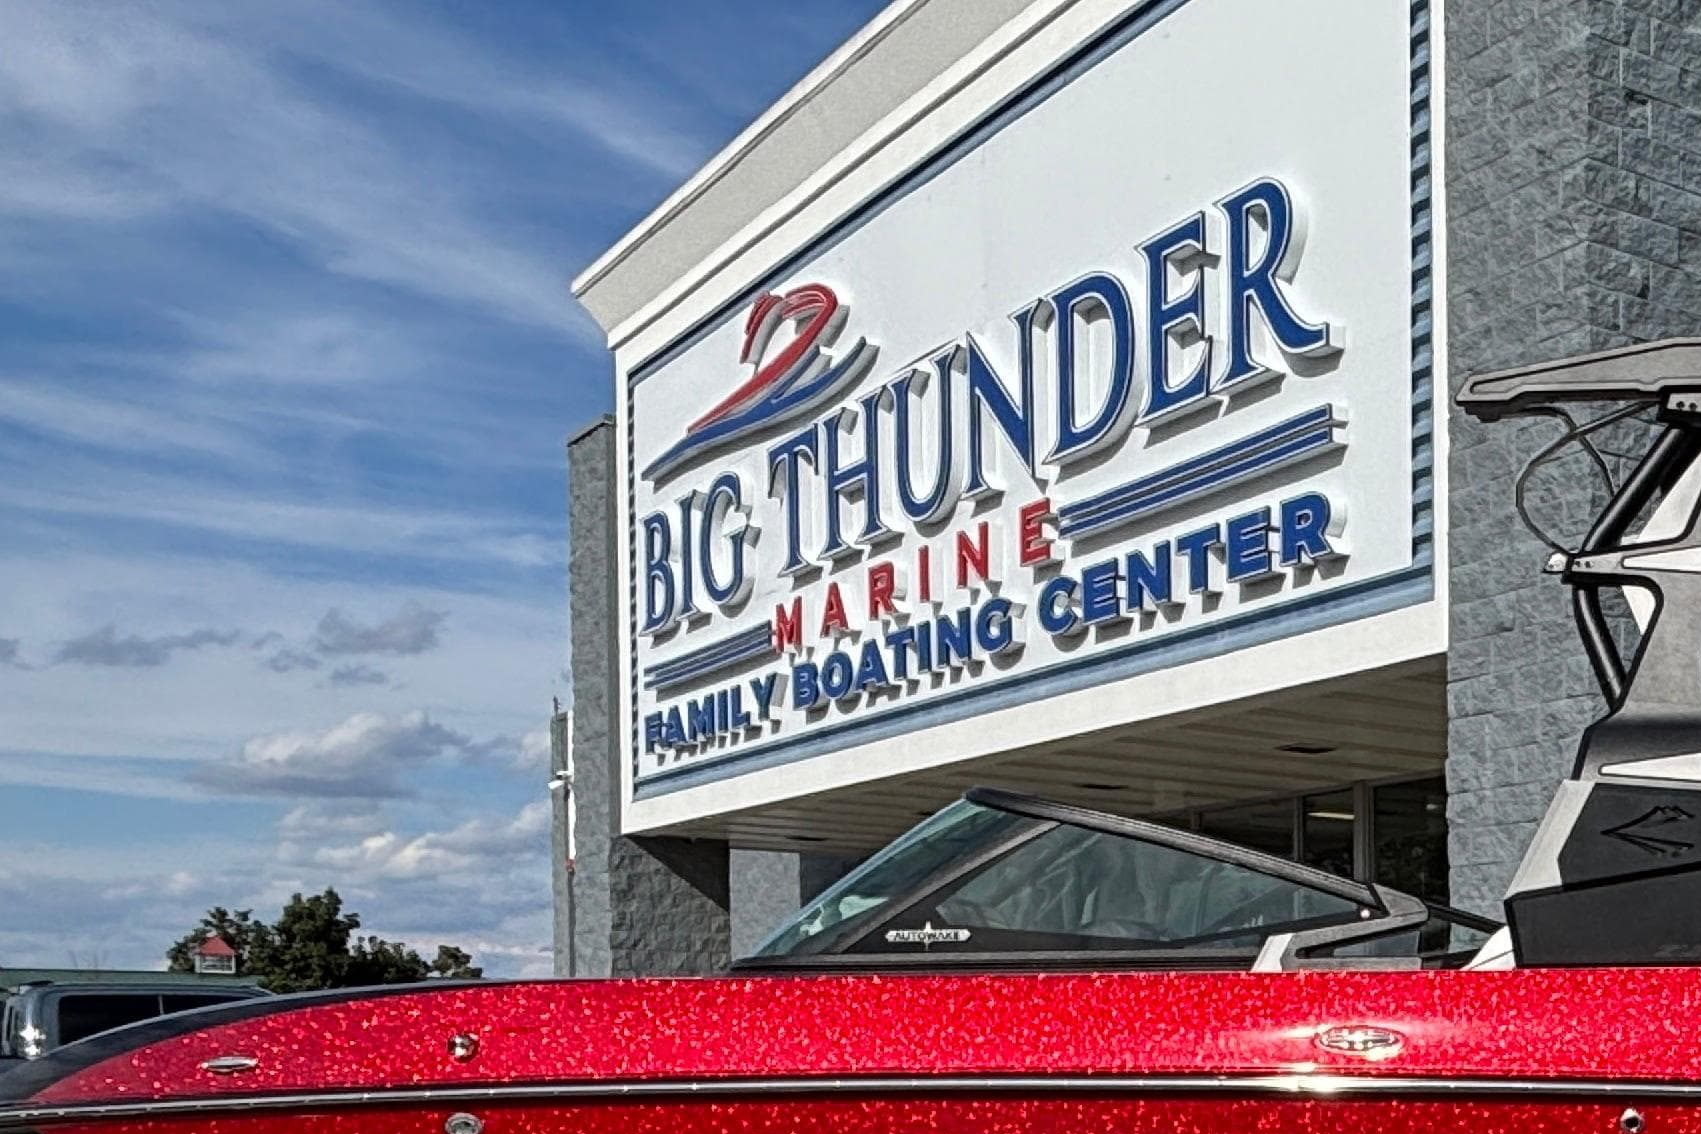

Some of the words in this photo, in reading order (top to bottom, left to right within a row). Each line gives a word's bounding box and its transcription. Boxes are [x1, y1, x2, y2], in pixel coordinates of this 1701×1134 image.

[639, 471, 748, 637] BIG
[767, 176, 1330, 578] THUNDER
[645, 672, 778, 755] FAMILY
[793, 597, 1012, 711] BOATING
[1037, 491, 1333, 635] CENTER
[773, 497, 1050, 654] MARINE
